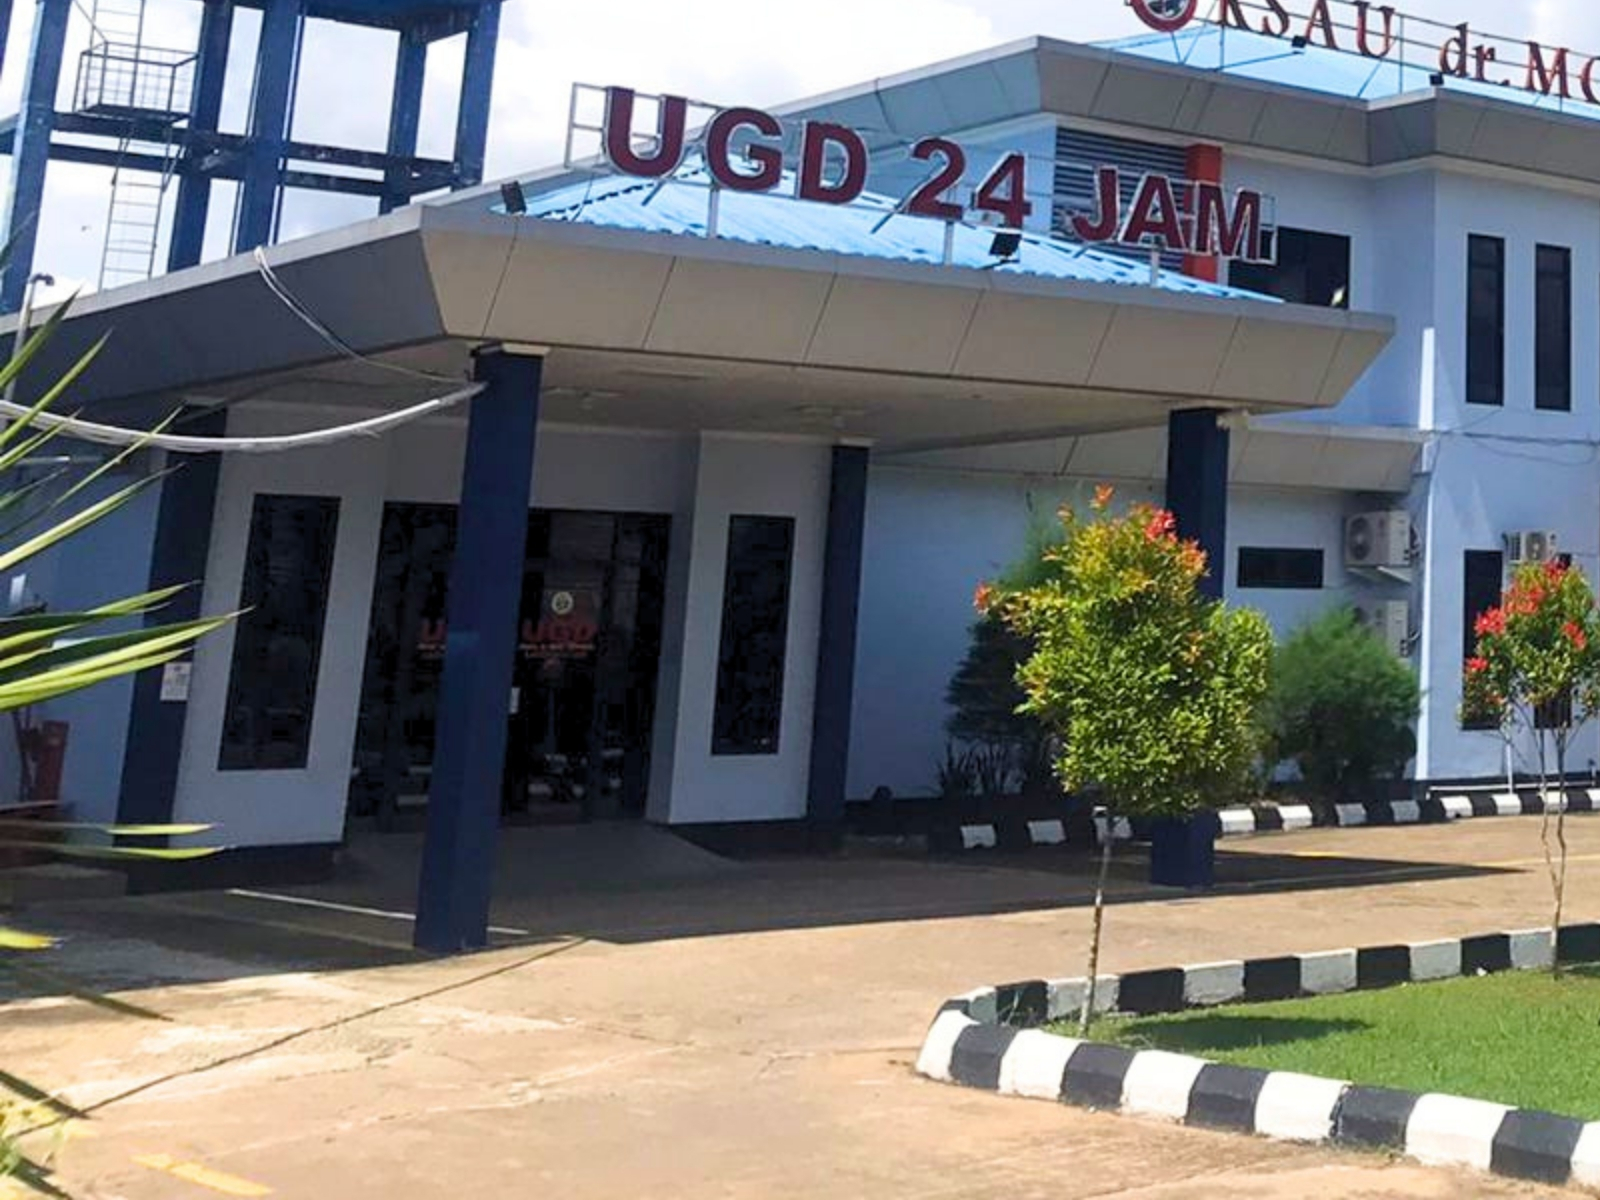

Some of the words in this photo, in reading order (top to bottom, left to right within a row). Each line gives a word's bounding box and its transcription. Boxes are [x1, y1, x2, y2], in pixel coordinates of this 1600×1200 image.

[1439, 22, 1511, 86] dr.
[603, 86, 869, 205] UGD
[908, 136, 1033, 231] 24
[1070, 165, 1264, 264] JAM
